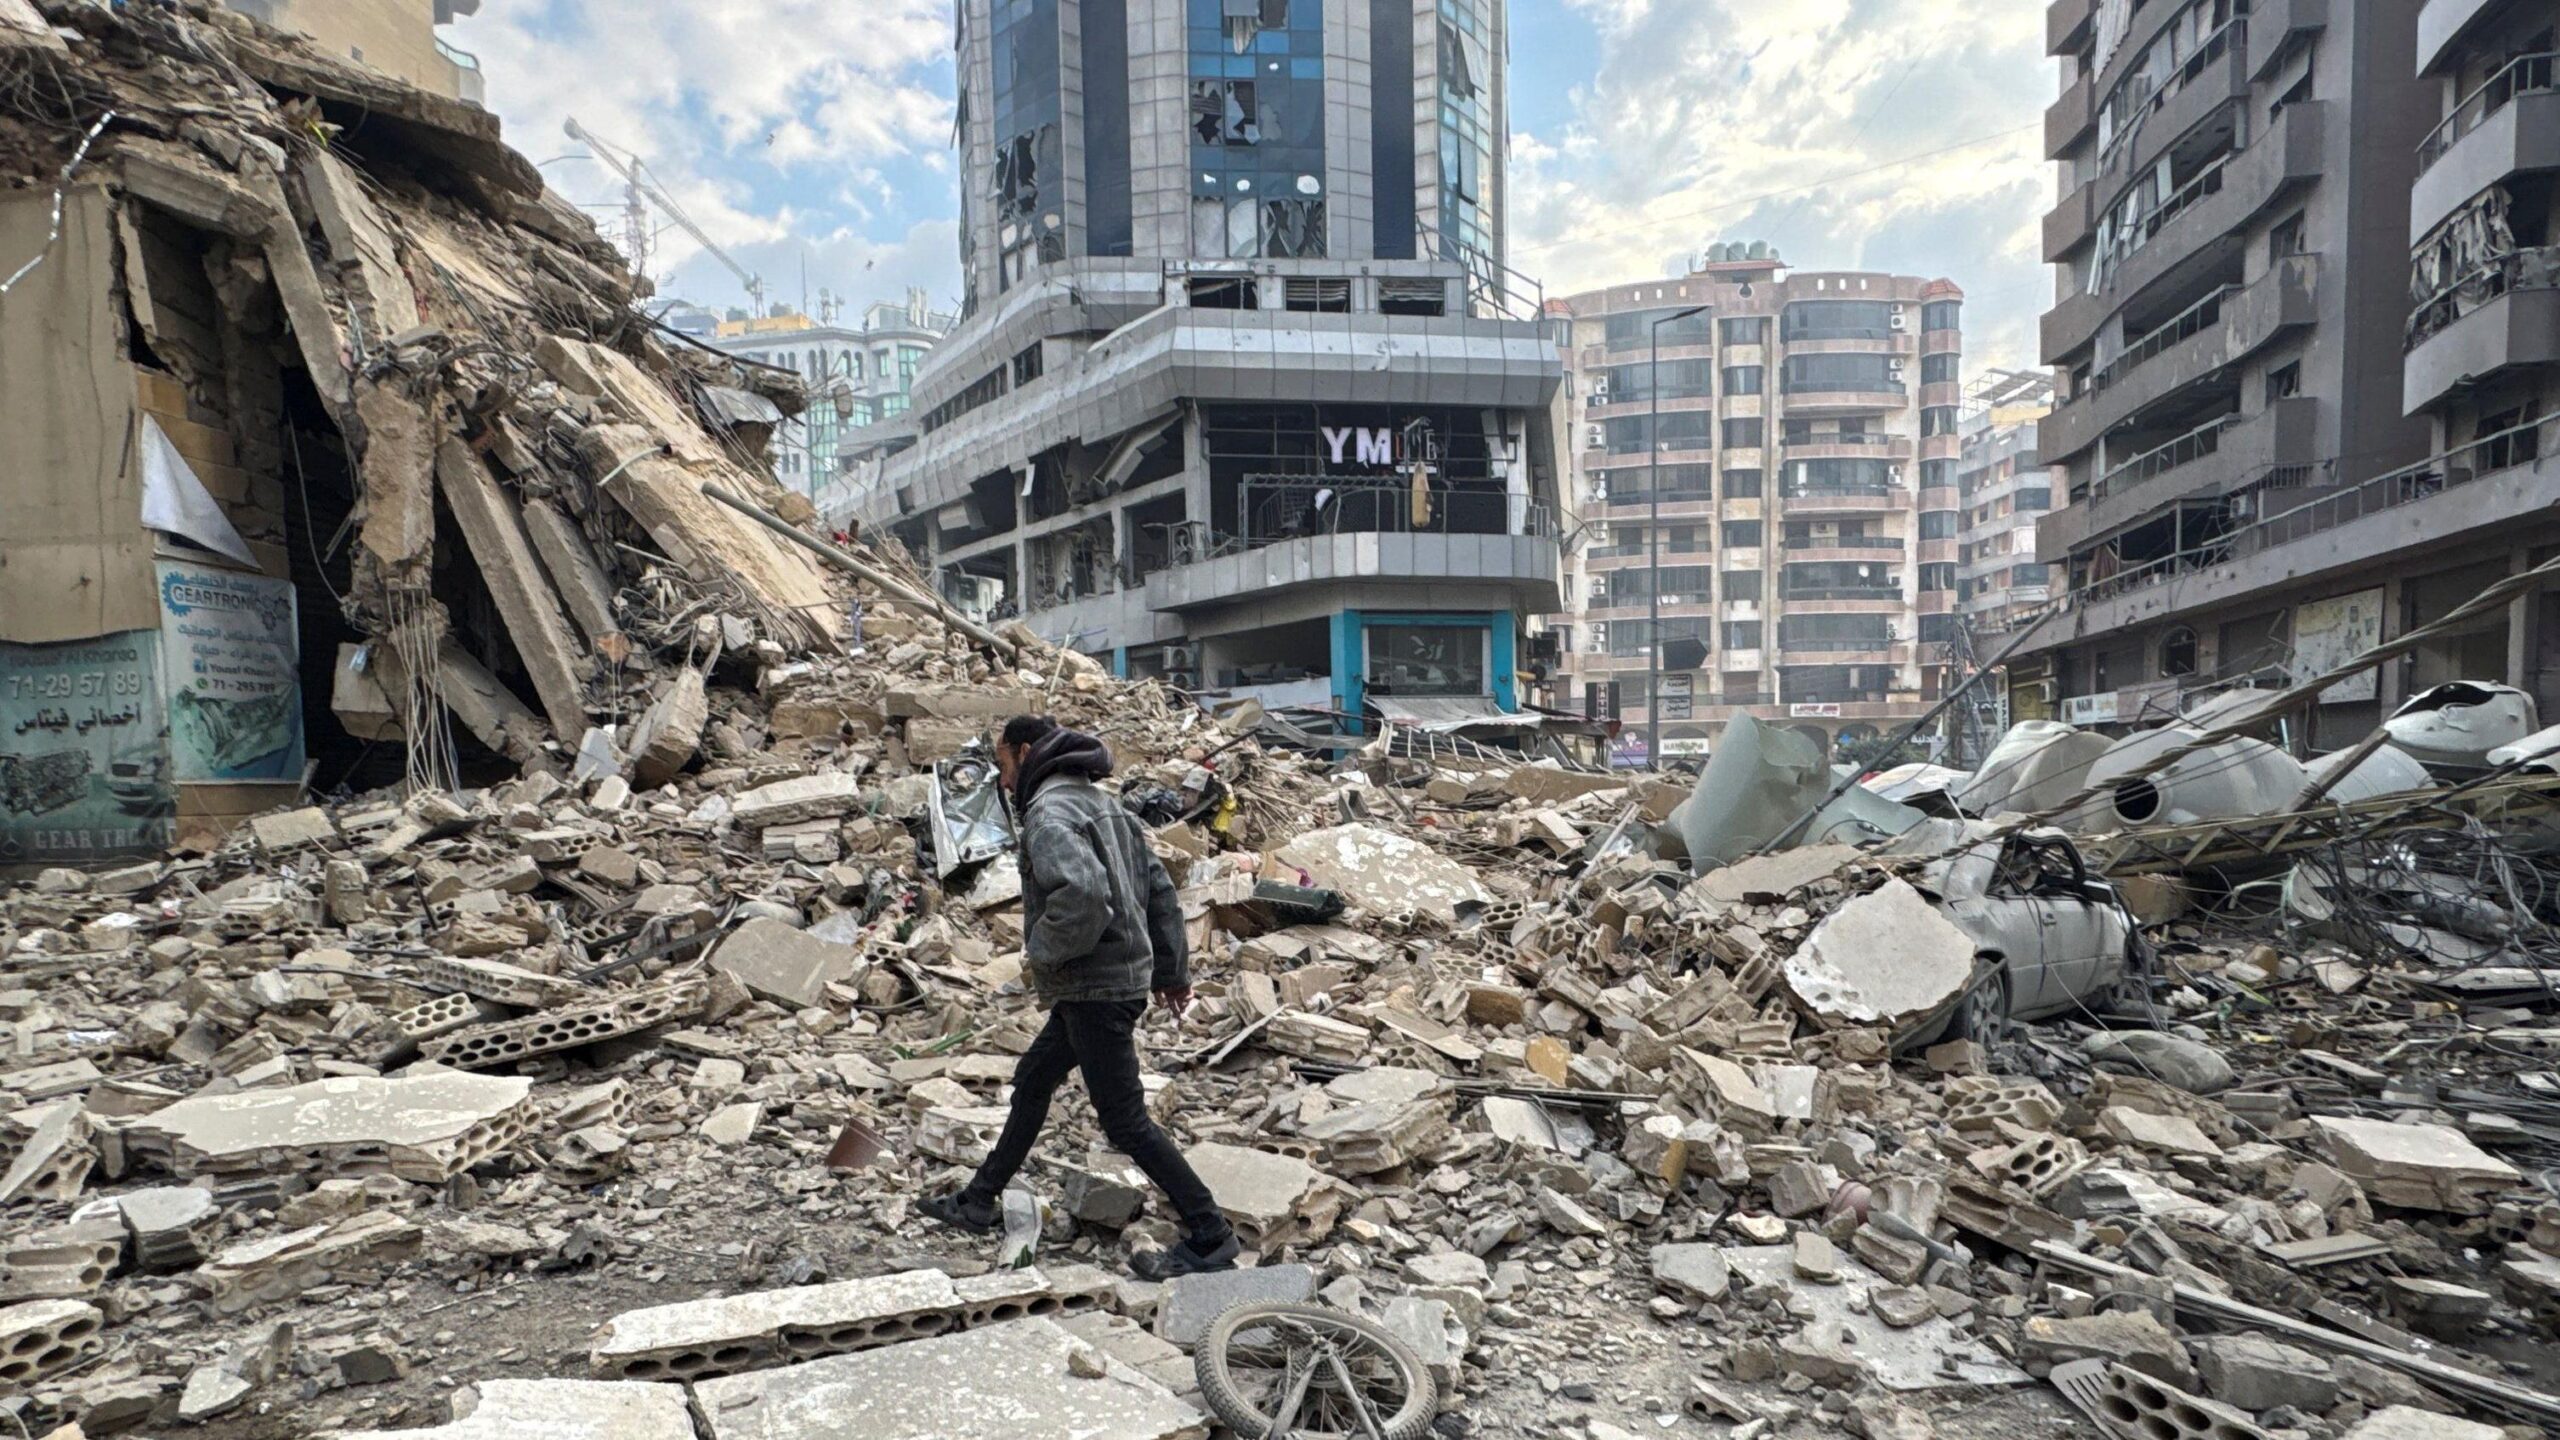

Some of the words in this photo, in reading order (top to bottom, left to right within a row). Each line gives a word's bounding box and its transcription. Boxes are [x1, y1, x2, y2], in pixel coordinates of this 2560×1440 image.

[80, 672, 106, 697] 57
[114, 670, 141, 695] 89
[35, 829, 93, 849] GEAR
